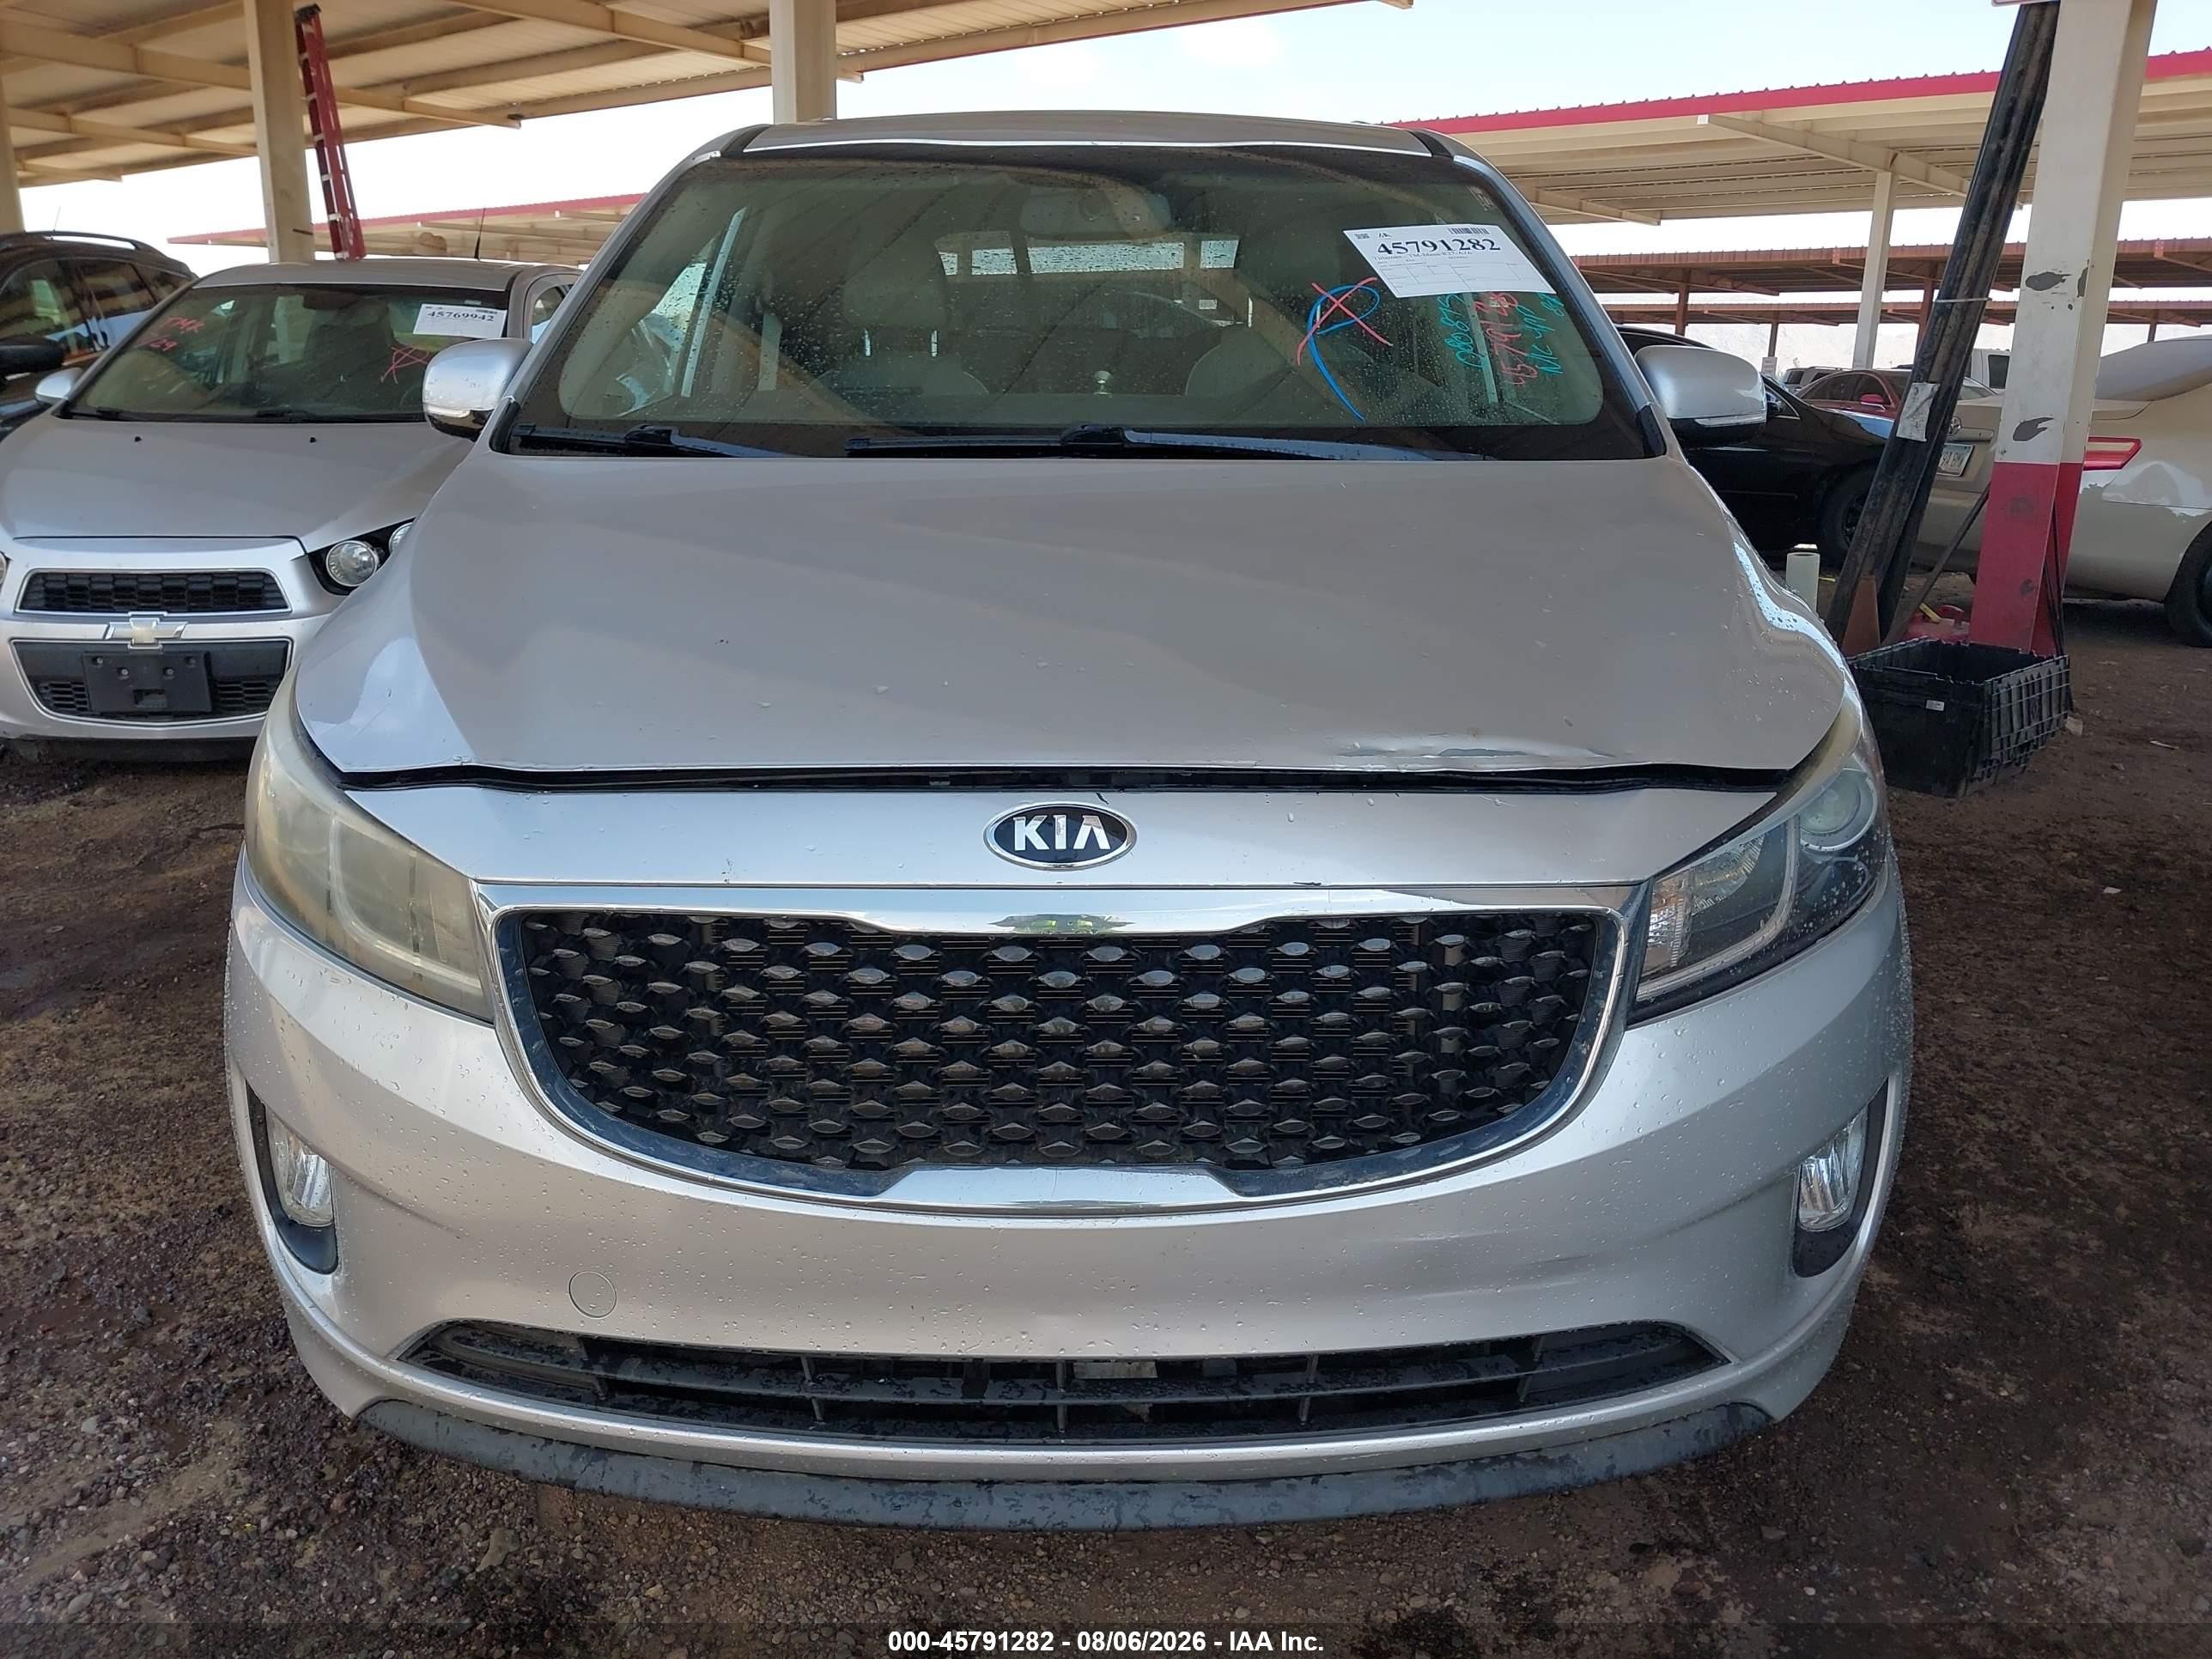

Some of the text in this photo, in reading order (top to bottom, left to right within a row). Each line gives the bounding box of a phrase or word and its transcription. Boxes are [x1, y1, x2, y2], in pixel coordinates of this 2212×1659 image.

[1376, 238, 1501, 255] 45791282
[427, 311, 495, 322] 45769942
[1012, 814, 1111, 852] KIA
